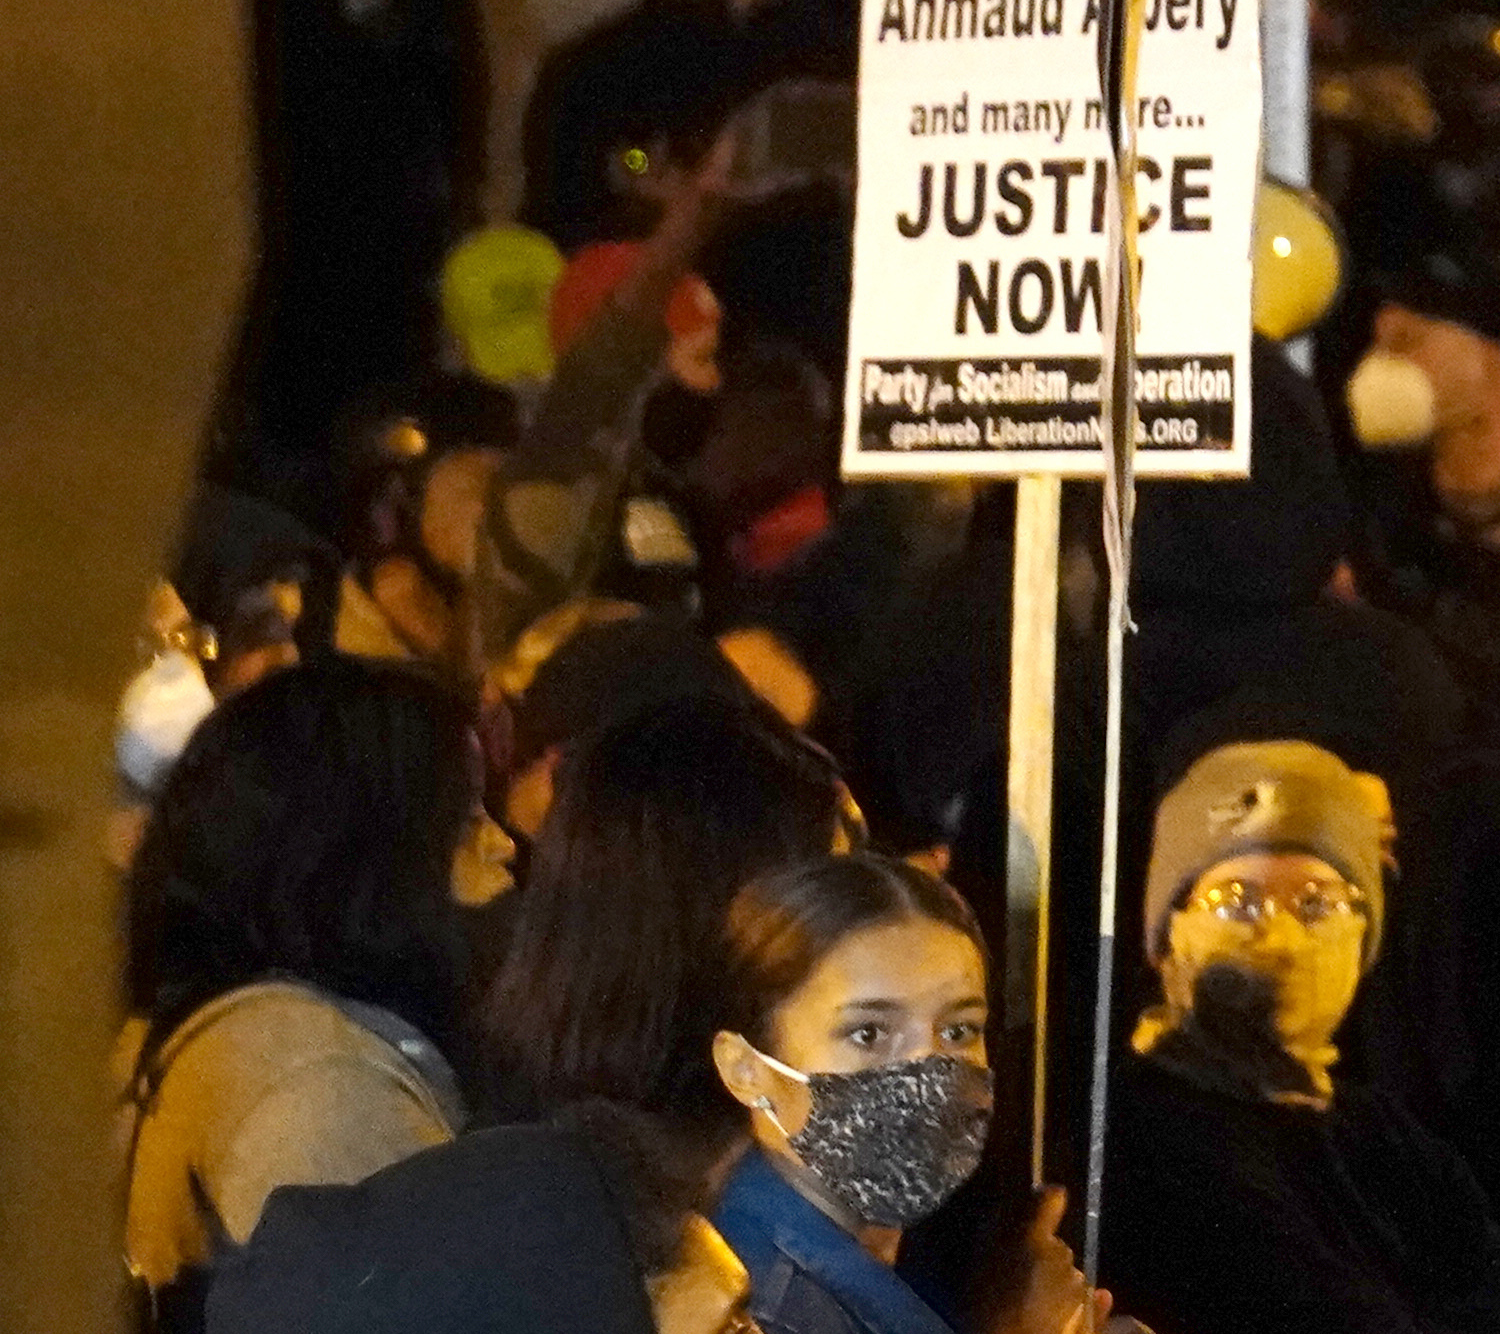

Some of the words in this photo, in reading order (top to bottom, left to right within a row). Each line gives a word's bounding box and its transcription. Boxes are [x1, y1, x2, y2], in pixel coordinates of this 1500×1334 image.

[909, 90, 970, 136] and
[980, 97, 1072, 144] many
[895, 154, 1214, 240] JUSTICE
[863, 362, 929, 415] Party
[957, 360, 1069, 406] Socialism
